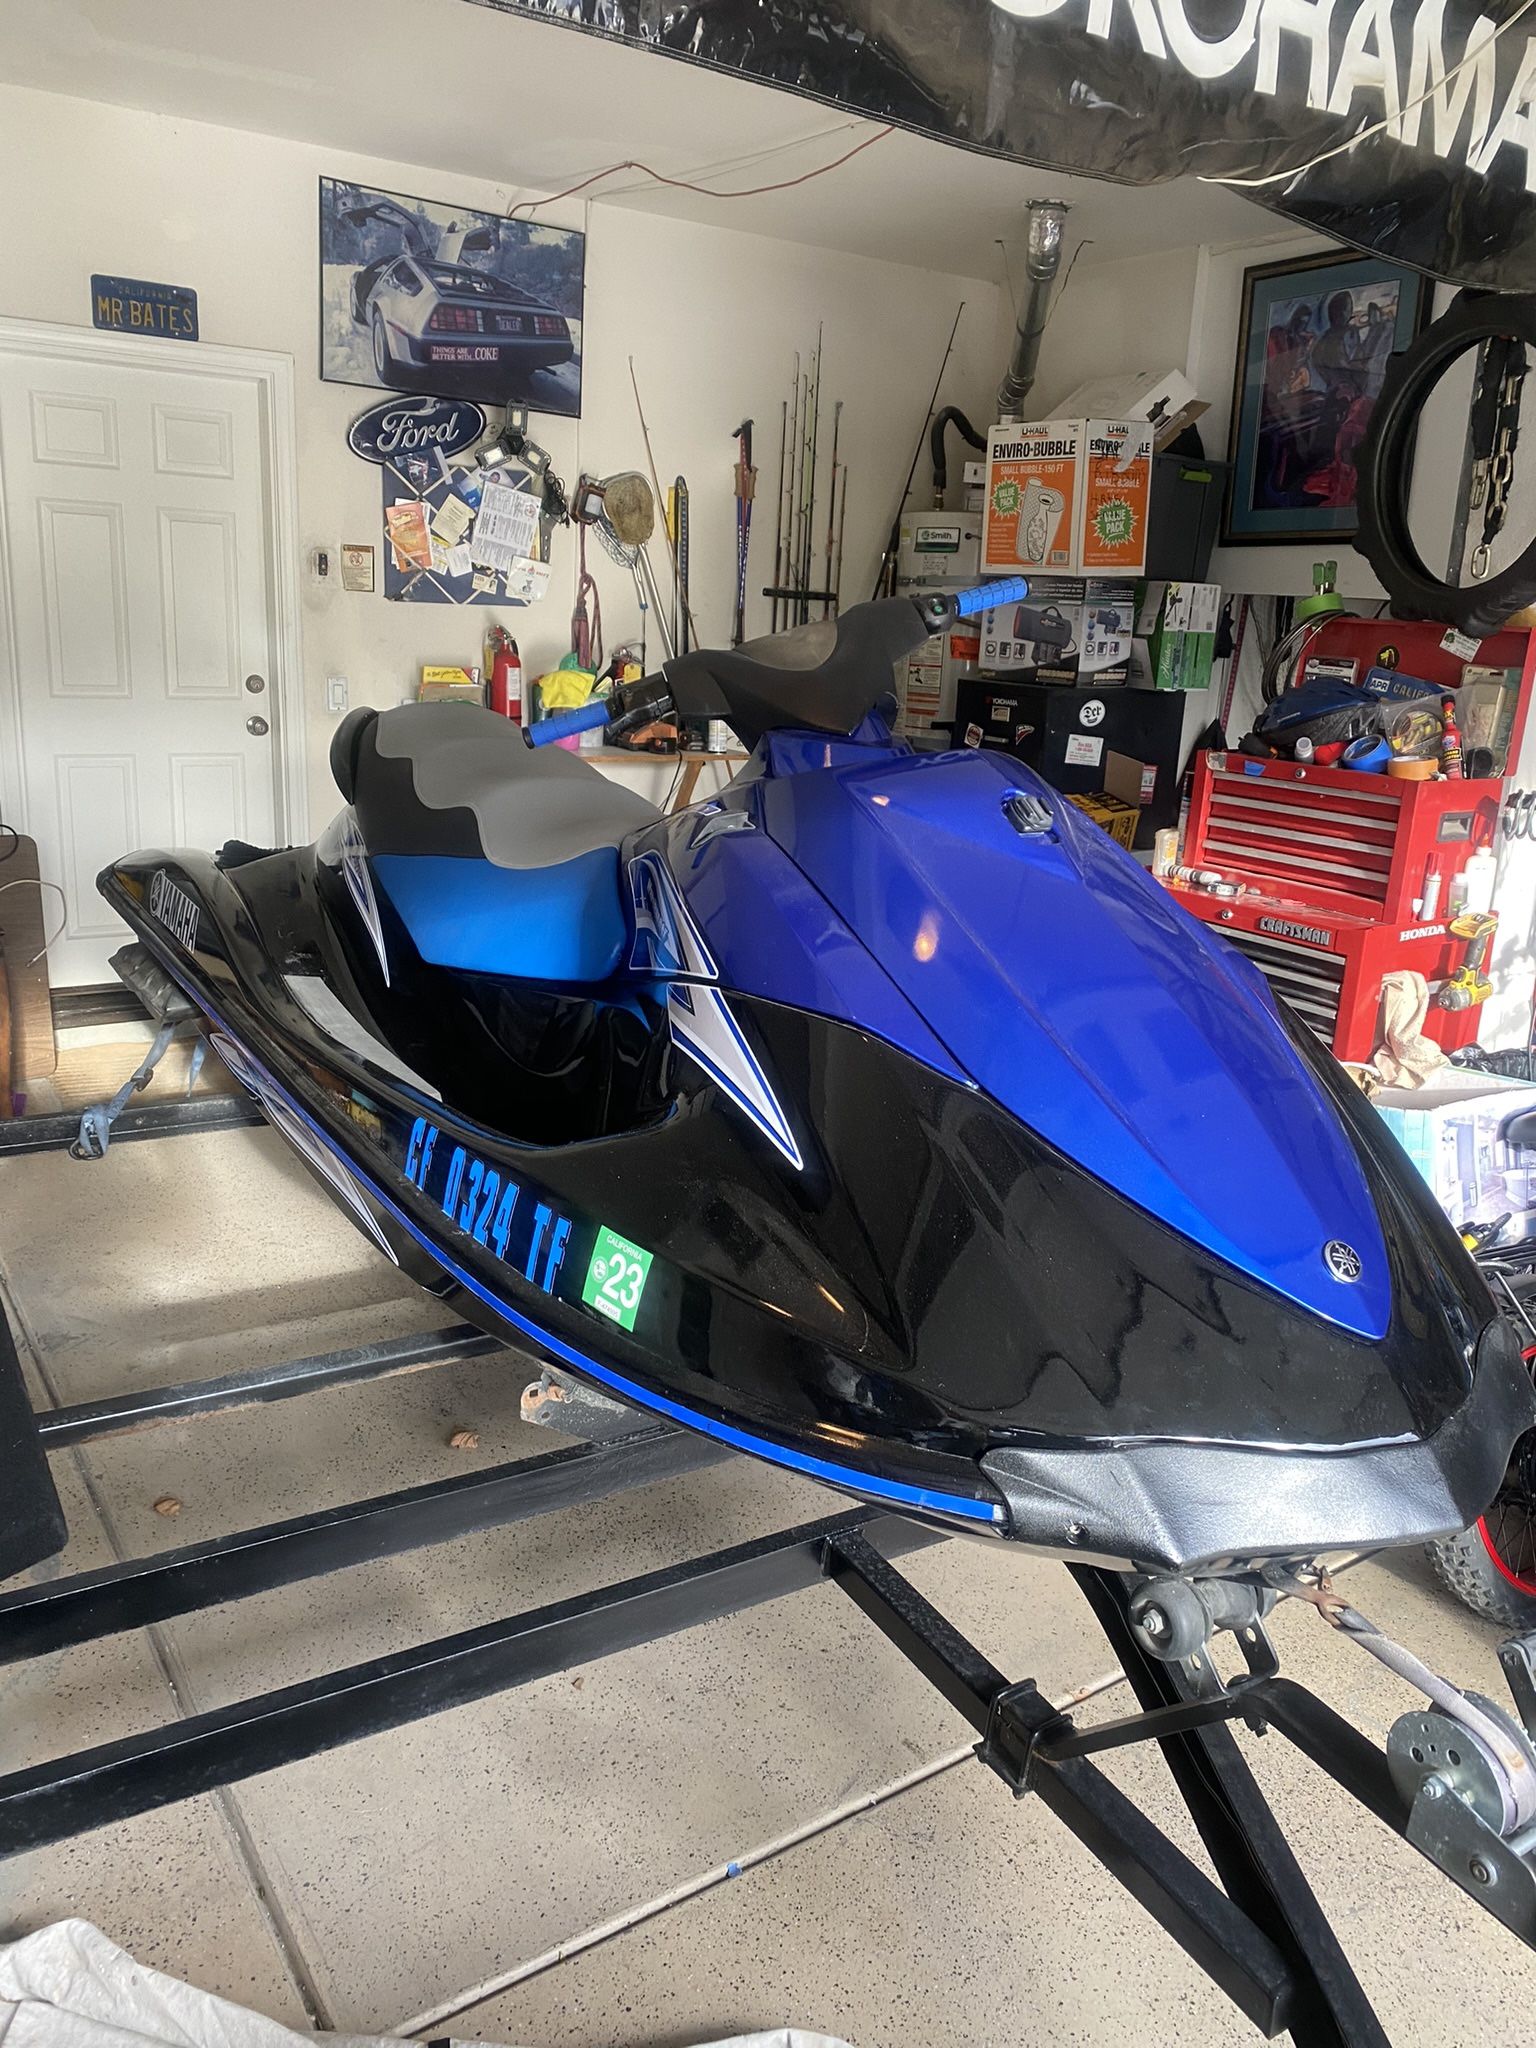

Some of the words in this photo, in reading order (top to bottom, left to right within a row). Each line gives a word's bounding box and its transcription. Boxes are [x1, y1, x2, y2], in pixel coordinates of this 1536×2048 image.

[97, 295, 123, 324] MR
[129, 299, 193, 333] BATES
[475, 347, 498, 360] COKE
[377, 404, 459, 452] Ford
[1022, 426, 1049, 436] U-HAUL
[992, 440, 1076, 459] ENVIRO-BUBBLE
[1000, 465, 1019, 475] SMALL
[931, 531, 952, 540] Smith
[1106, 519, 1125, 534] PACK
[1370, 679, 1388, 691] APR
[156, 871, 200, 954] YAMAHA
[1260, 917, 1331, 946] CRAFTSMAN
[1400, 924, 1447, 942] HONDA
[404, 1116, 440, 1192] CF
[441, 1146, 520, 1261] 0324
[525, 1200, 573, 1295] TF
[606, 1234, 643, 1262] CALIFORNIA
[602, 1252, 643, 1309] 23
